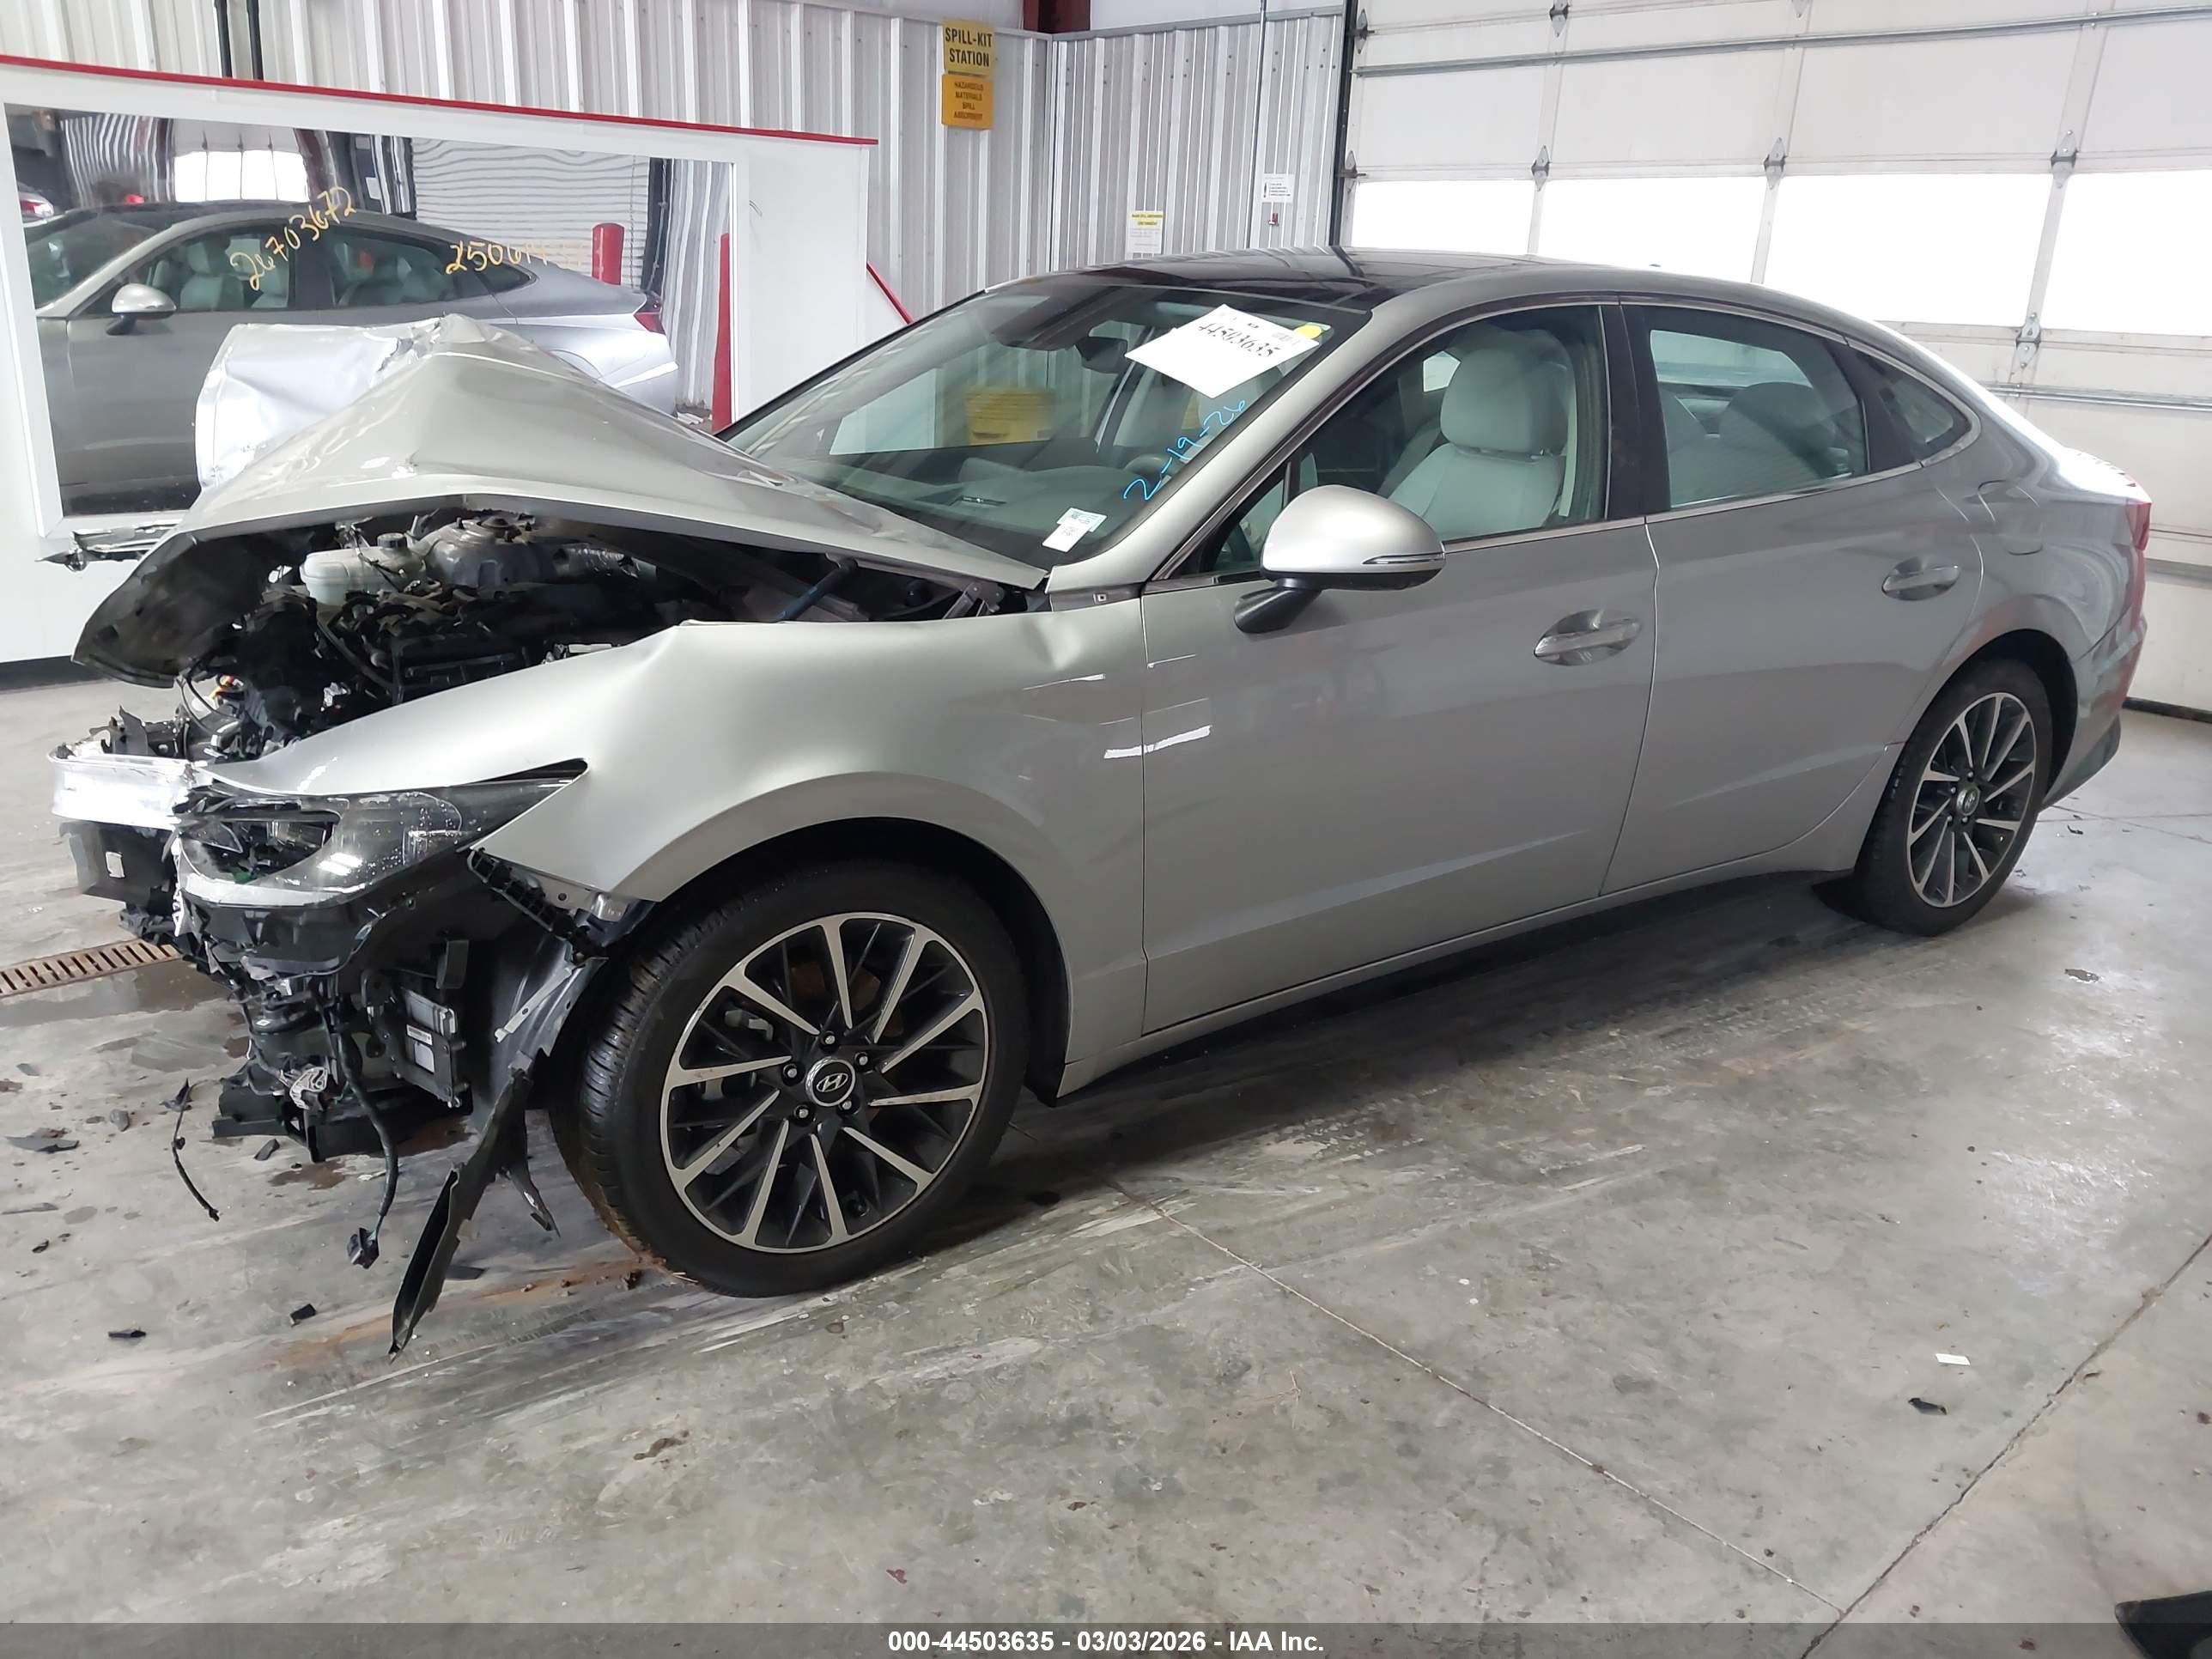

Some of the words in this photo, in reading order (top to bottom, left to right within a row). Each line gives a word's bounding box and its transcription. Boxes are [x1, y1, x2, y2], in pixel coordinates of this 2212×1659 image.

[945, 27, 993, 47] SPILL-KIT
[949, 48, 989, 67] STATION
[1122, 399, 1246, 501] 2-19-26
